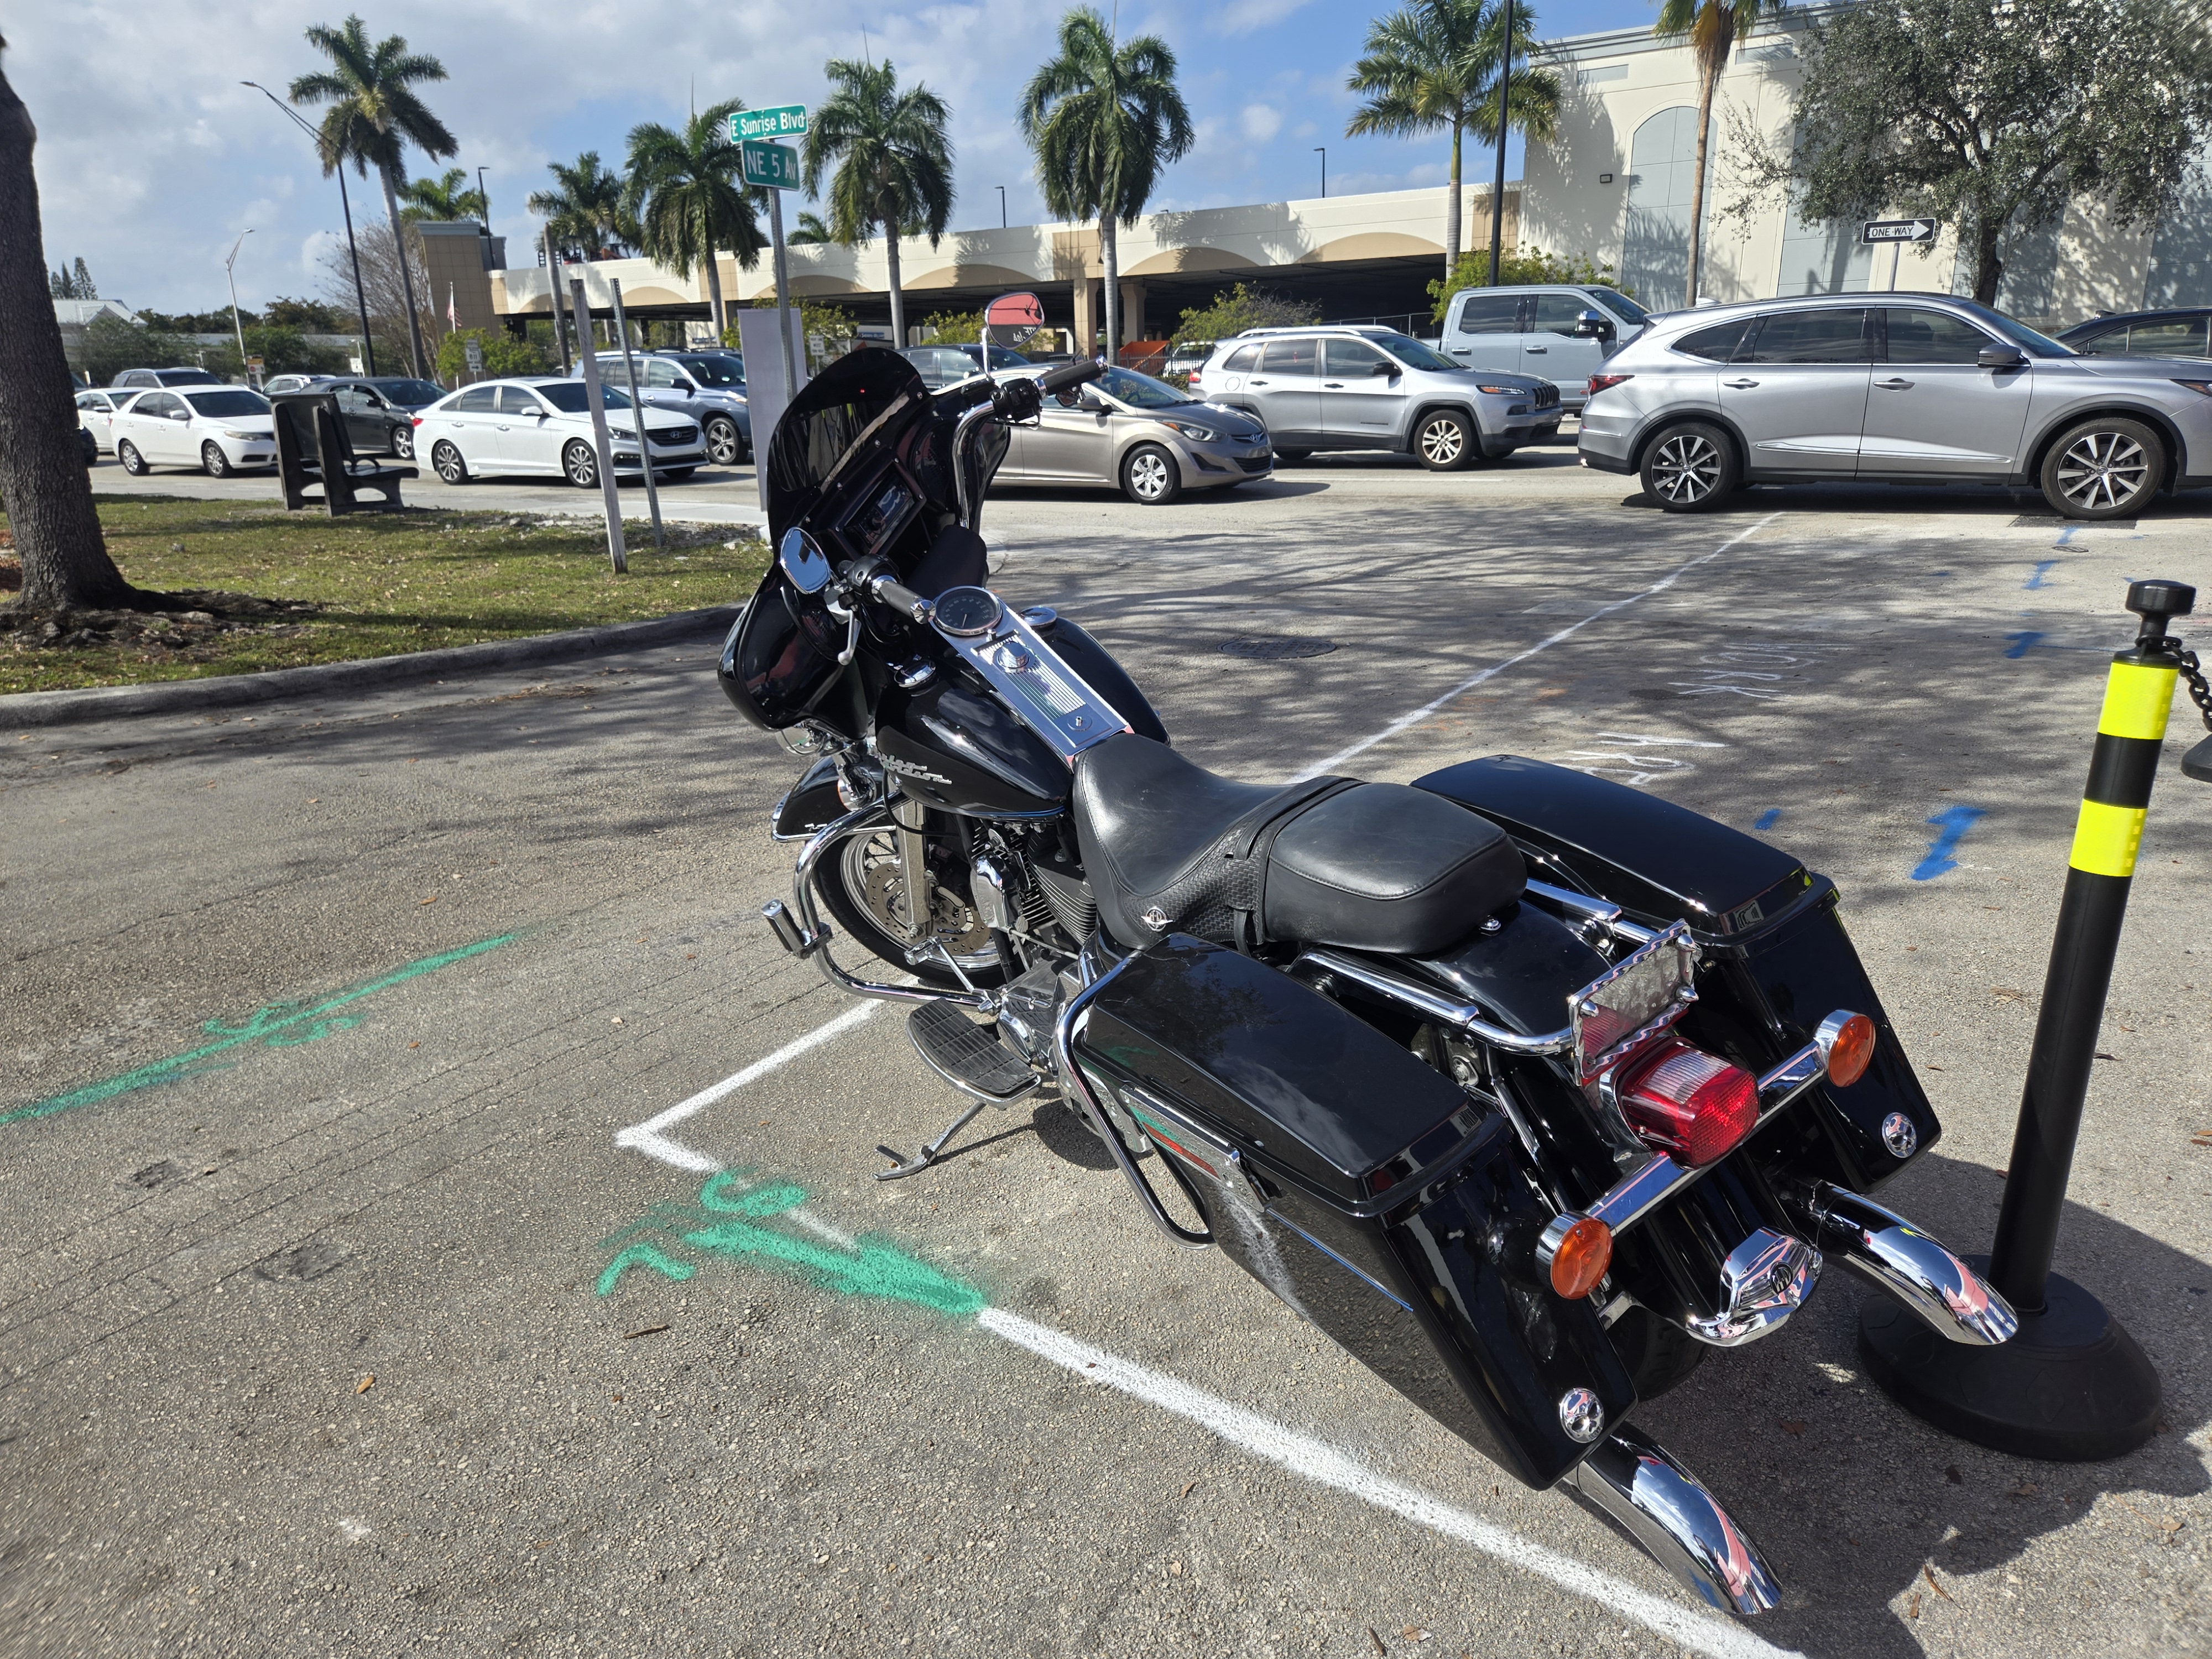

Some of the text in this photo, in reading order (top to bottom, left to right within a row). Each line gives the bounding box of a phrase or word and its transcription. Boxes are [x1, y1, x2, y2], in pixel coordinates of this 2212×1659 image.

[731, 112, 805, 137] E Sunrise Blvd
[747, 150, 767, 176] NE
[772, 153, 780, 178] 5
[1871, 226, 1914, 237] ONE WAY
